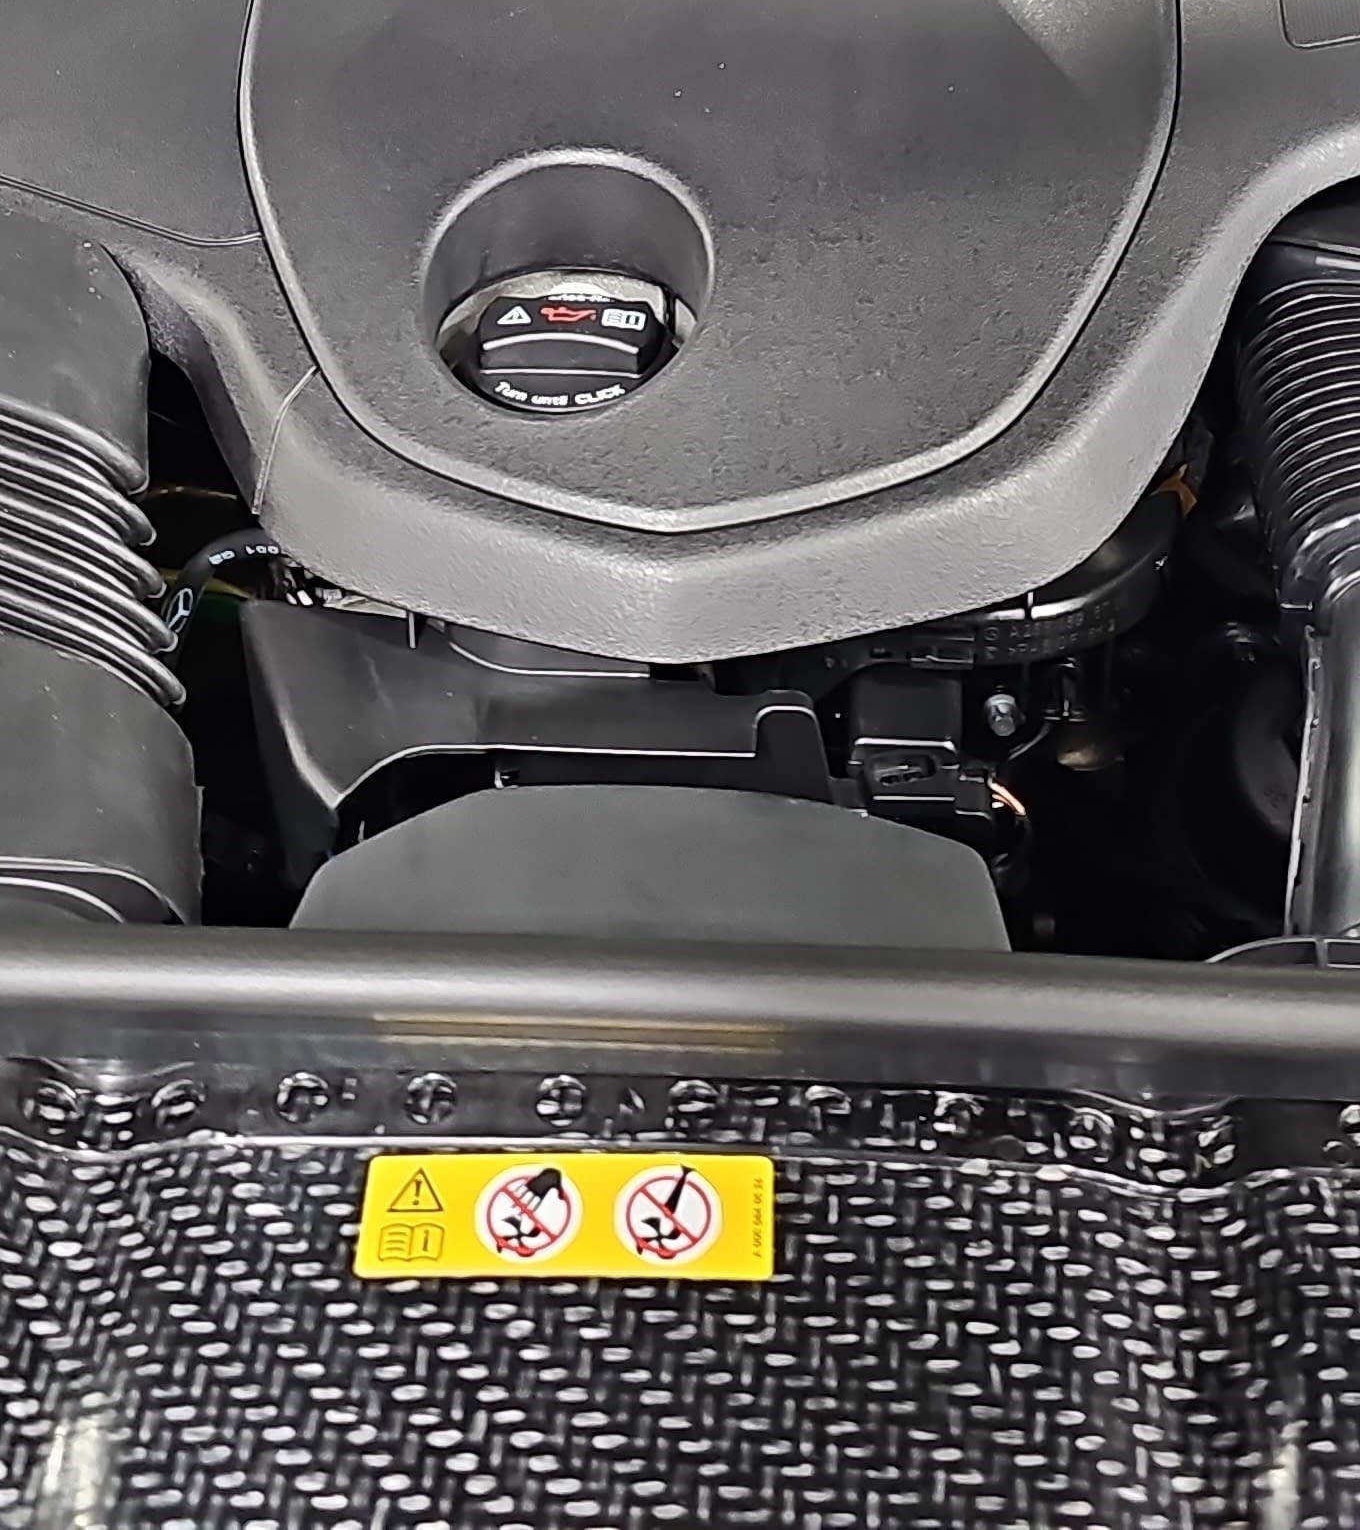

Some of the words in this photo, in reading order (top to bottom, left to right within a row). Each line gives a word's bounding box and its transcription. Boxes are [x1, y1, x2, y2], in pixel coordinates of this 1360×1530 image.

[494, 381, 528, 402] Turn
[530, 394, 569, 406] until
[574, 383, 626, 405] CLICK
